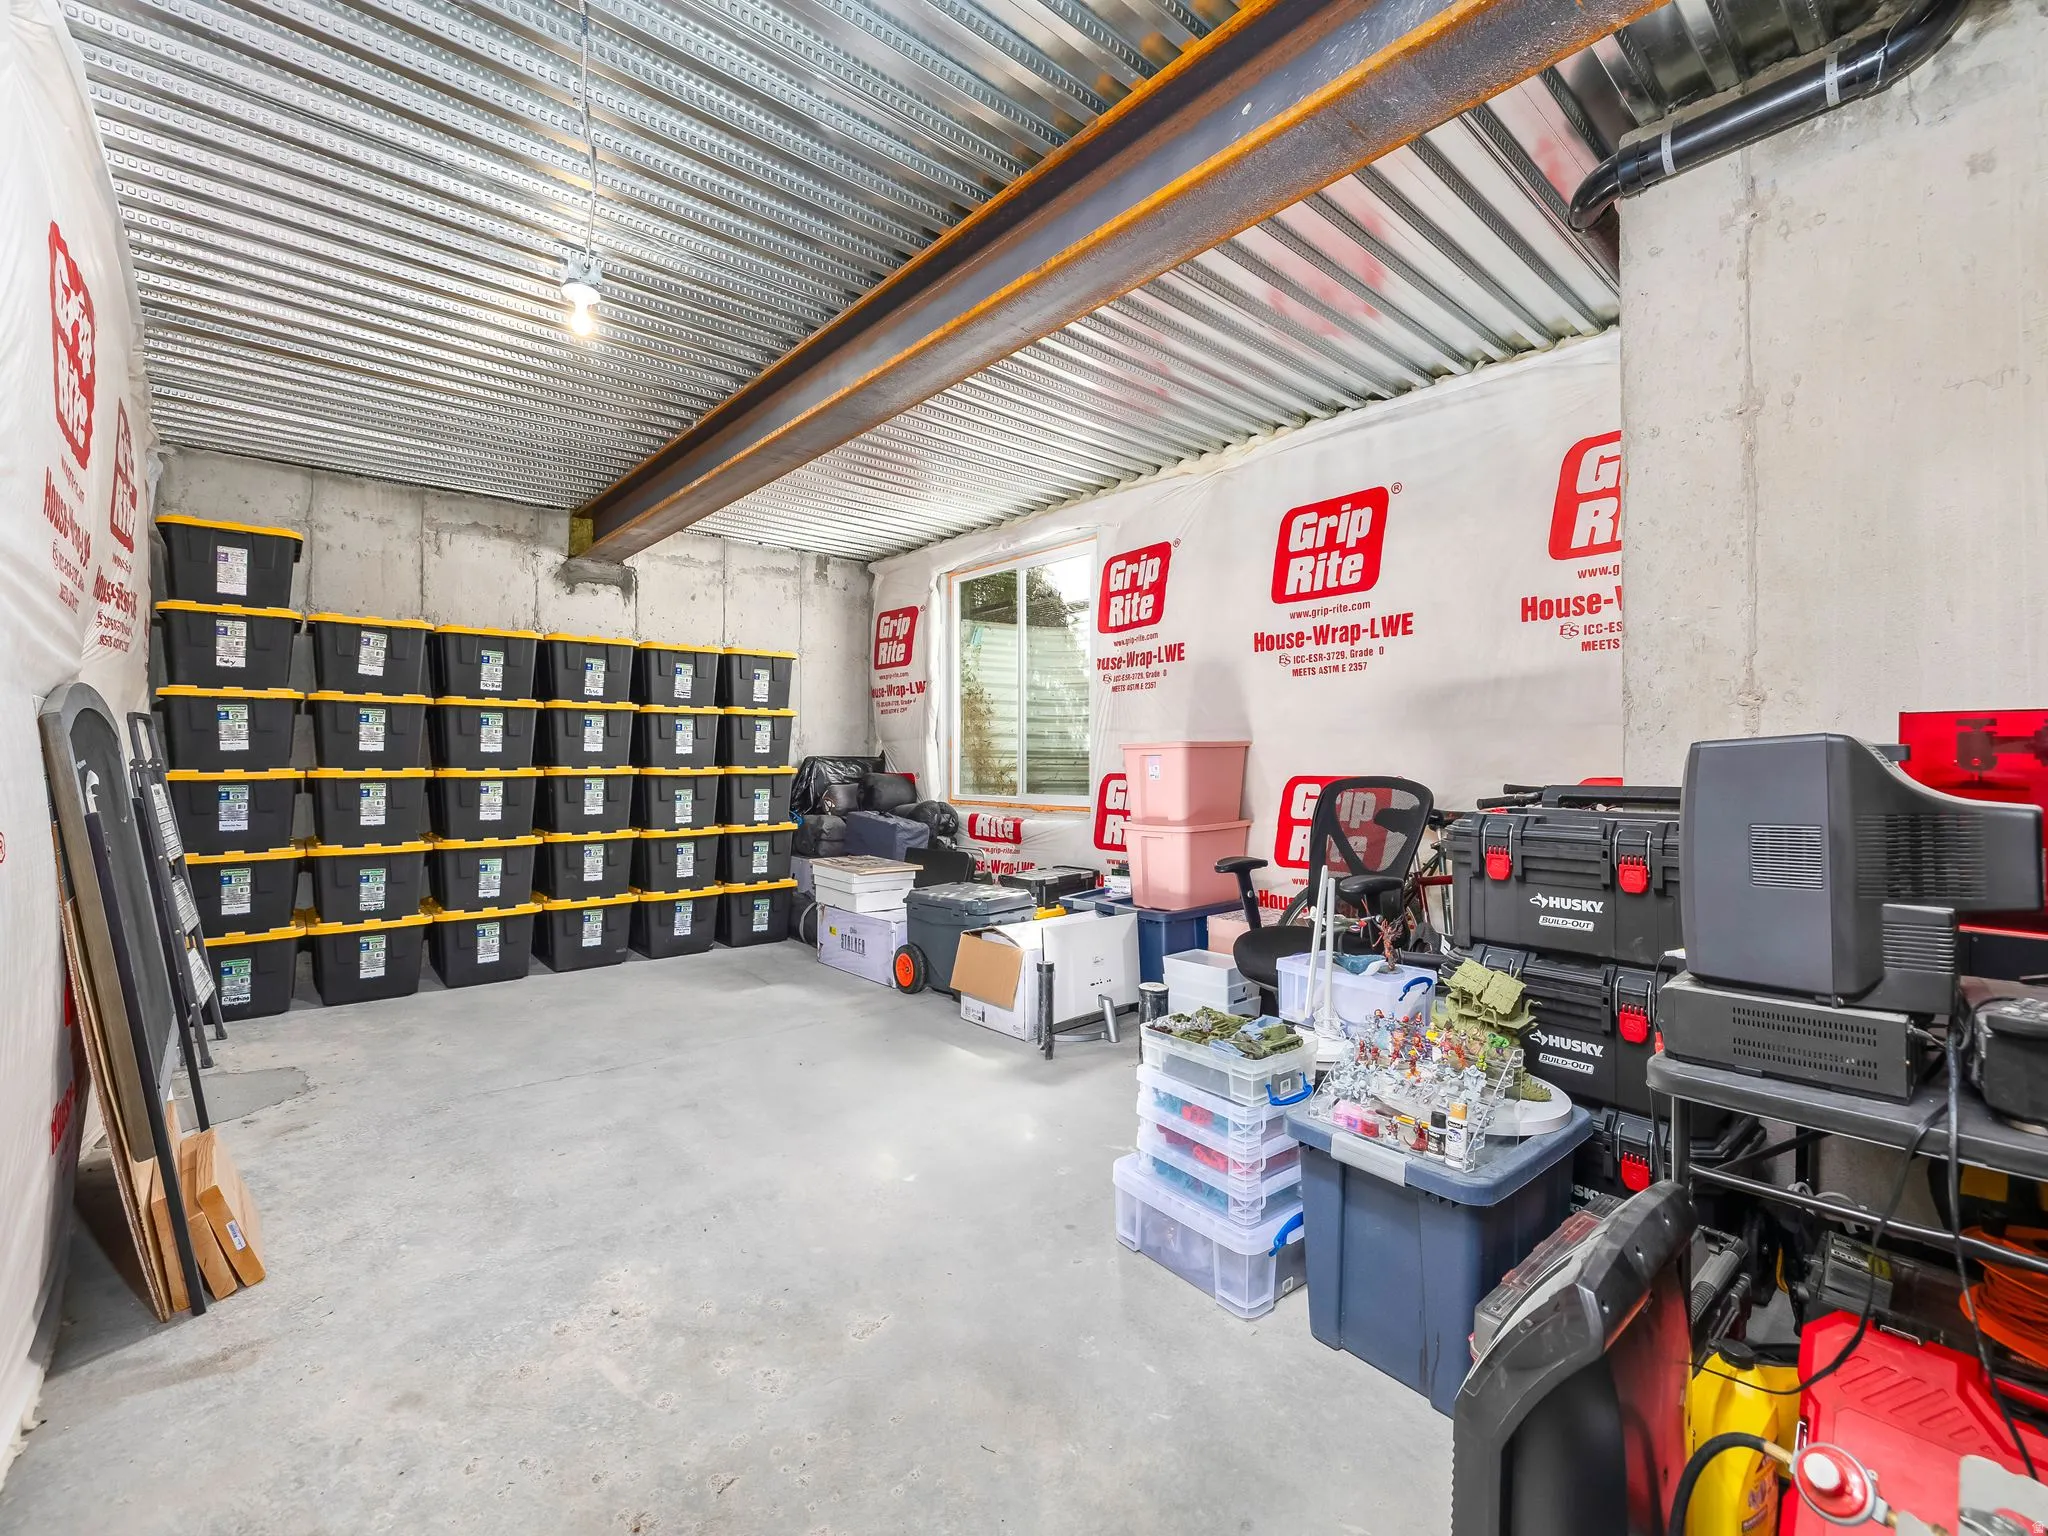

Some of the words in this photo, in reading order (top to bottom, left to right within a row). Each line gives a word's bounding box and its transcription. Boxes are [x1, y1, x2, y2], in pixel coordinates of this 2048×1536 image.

[1288, 502, 1373, 553] Grip
[1109, 554, 1161, 592] Grip
[1284, 550, 1364, 596] Rite
[1108, 592, 1154, 628] Rite
[1289, 601, 1371, 619] www.grip-rite.com
[879, 613, 911, 640] Grip
[1253, 612, 1414, 653] House-Wrap-LWE
[1113, 632, 1159, 647] www.grip-rite.com
[1581, 638, 1620, 652] MEETS
[877, 640, 906, 666] Rite
[1350, 647, 1374, 659] Grade
[1292, 667, 1317, 677] MEETS
[1318, 664, 1340, 675] ASTM
[1341, 664, 1346, 673] E
[1348, 661, 1368, 672] 2357
[975, 814, 1014, 839] Rite
[1548, 896, 1604, 913] HUSKY
[1542, 916, 1591, 929] BUILD-OUT
[1548, 1034, 1604, 1058] HUSKY
[1541, 1054, 1591, 1071] BUILD-OUT
